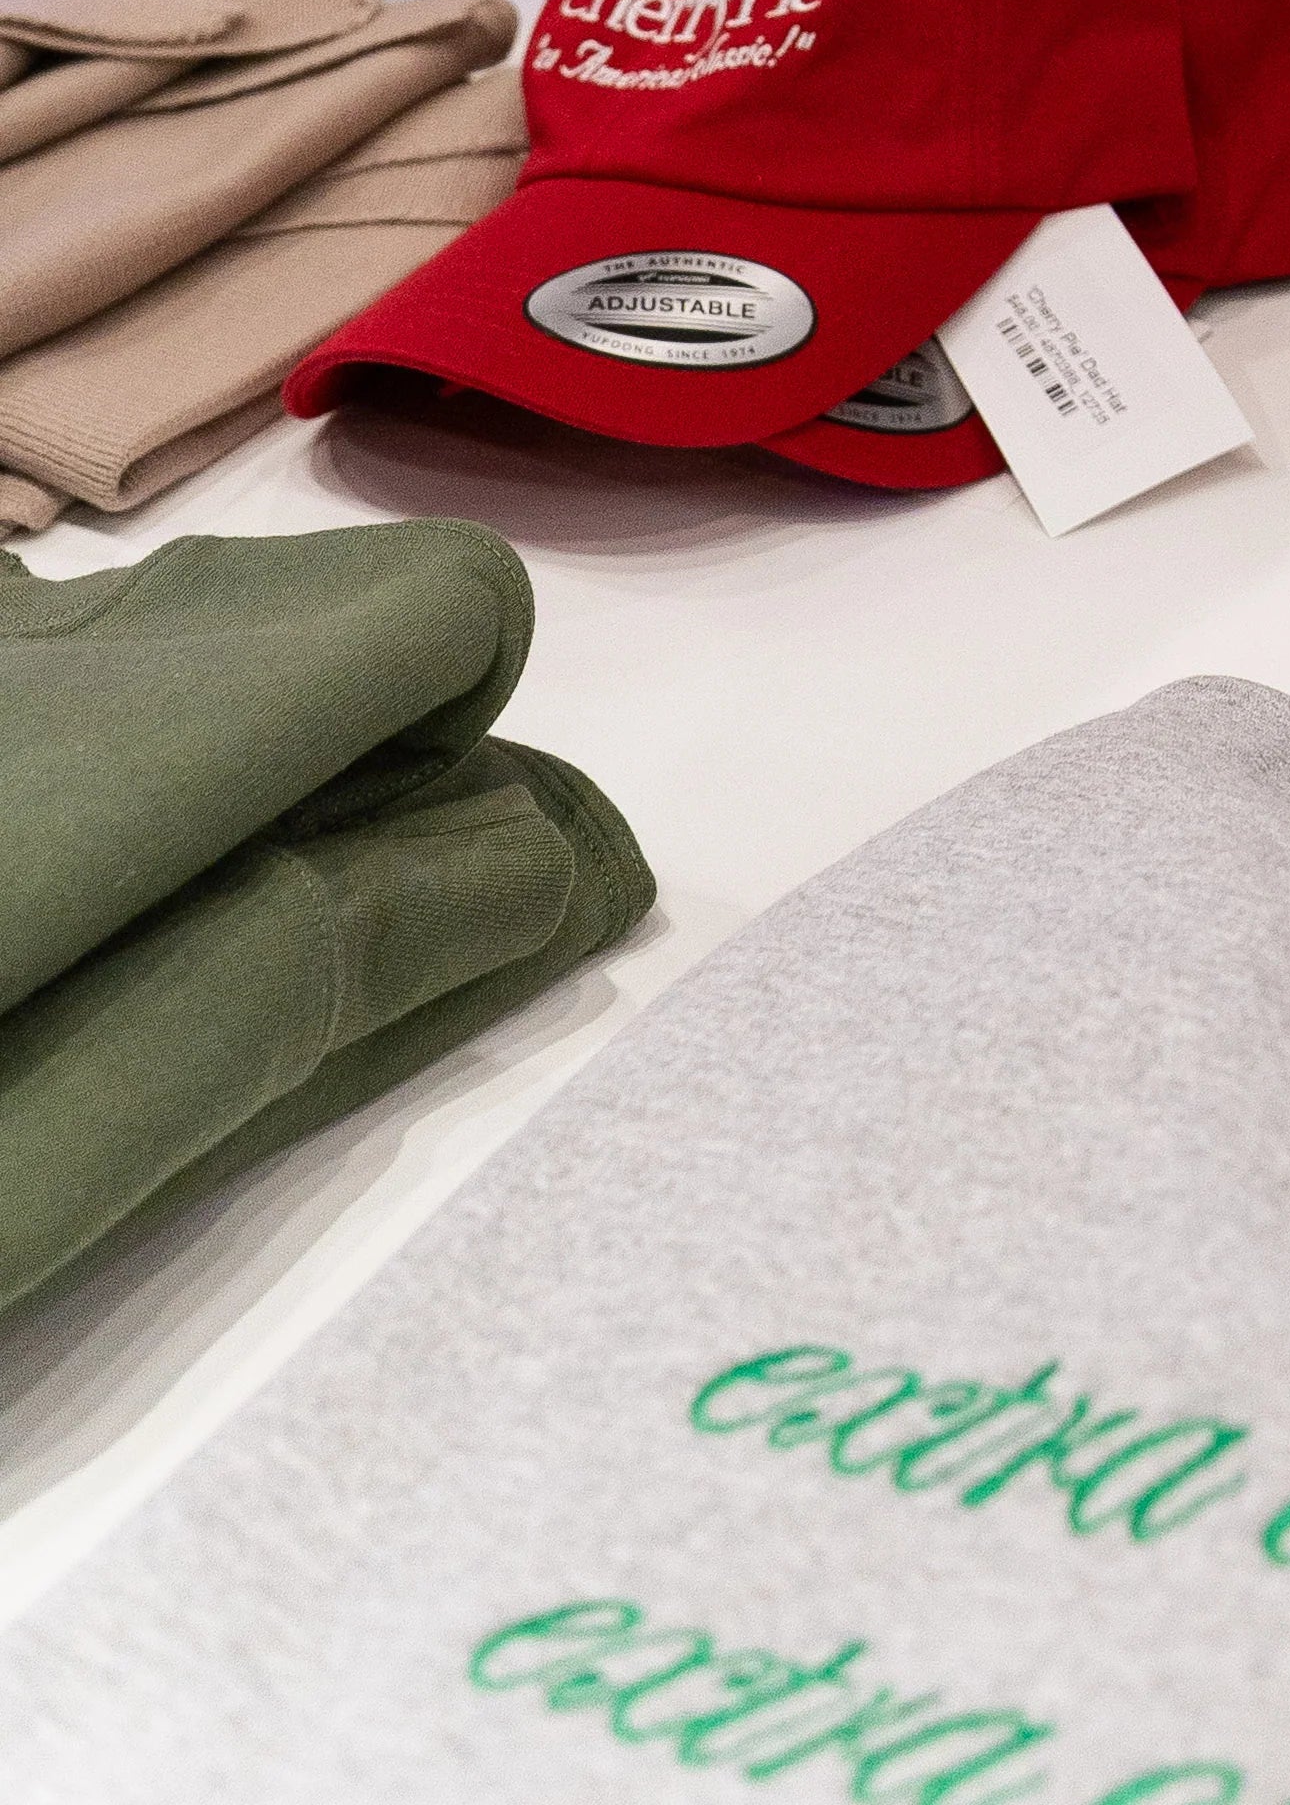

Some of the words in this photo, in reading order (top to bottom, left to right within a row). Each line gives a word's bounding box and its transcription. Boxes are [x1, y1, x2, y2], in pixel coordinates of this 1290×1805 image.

[648, 256, 747, 274] AUTHENTIC
[588, 296, 758, 319] ADJUSTABLE
[690, 1345, 1250, 1543] extra
